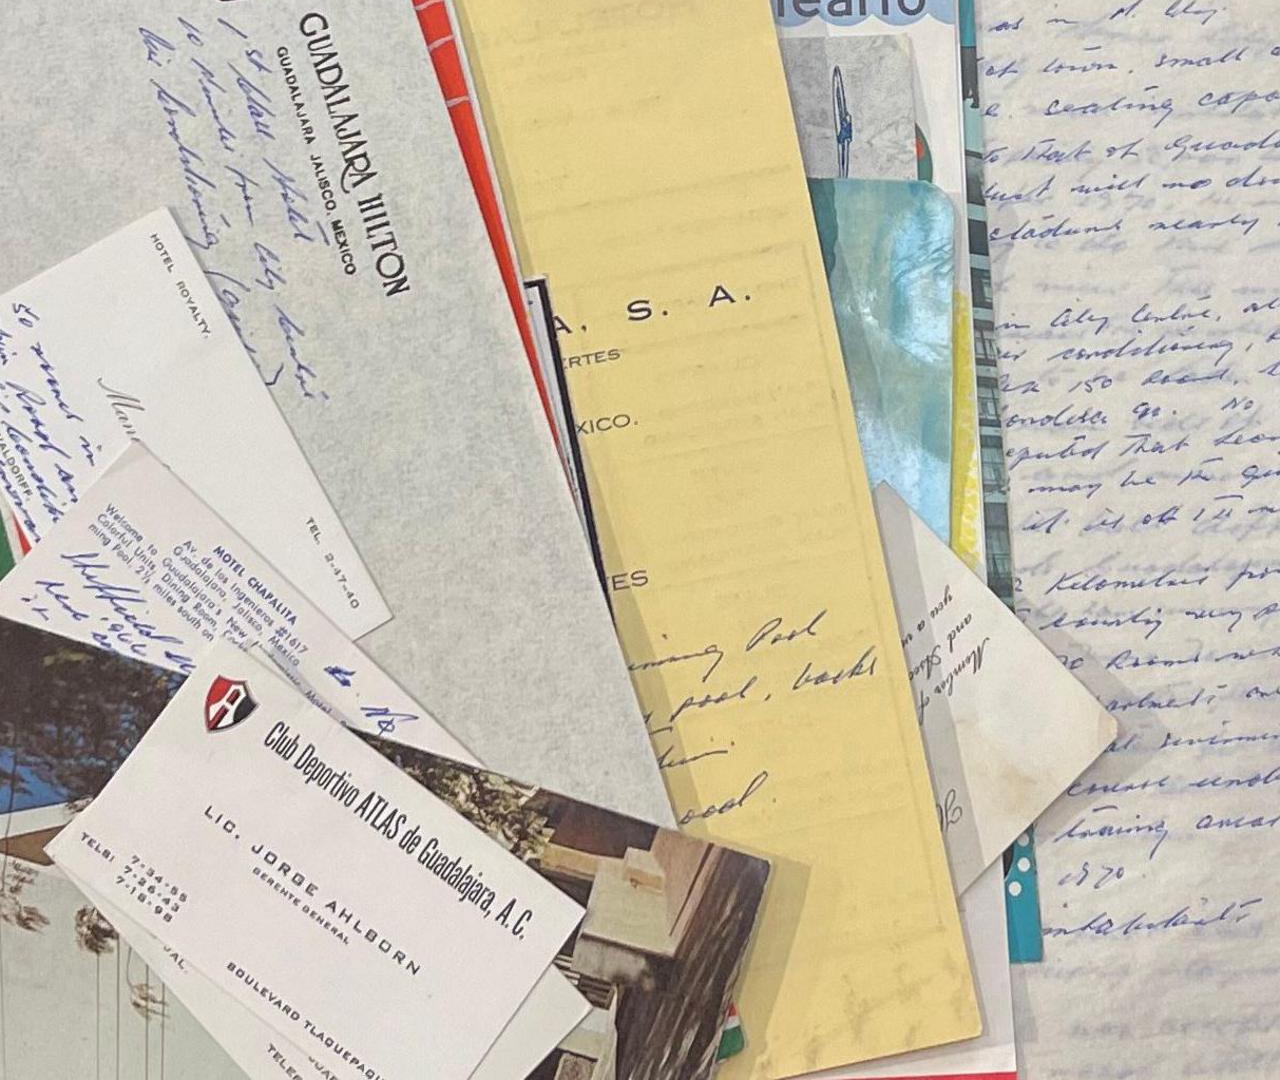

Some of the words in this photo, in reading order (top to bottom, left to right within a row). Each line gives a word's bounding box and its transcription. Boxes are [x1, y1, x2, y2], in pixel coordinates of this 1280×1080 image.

[276, 46, 315, 145] GUADALAJARA
[309, 153, 337, 216] JALISCO,
[330, 218, 357, 276] MEXICO
[298, 12, 378, 194] GUADALAJARA
[358, 192, 411, 297] HILTON
[149, 232, 176, 274] HOTEL
[627, 299, 669, 321] S.
[708, 285, 751, 308] A.
[88, 523, 111, 547] ming
[152, 582, 176, 608] miles
[177, 606, 202, 635] south
[201, 628, 215, 643] on
[97, 514, 133, 549] Colorful
[160, 574, 192, 605] Dining
[105, 503, 144, 543] Welcome
[147, 544, 159, 557] to
[226, 616, 248, 640] New
[213, 545, 244, 578] MOTEL
[247, 577, 298, 626] CHAPALITA
[608, 569, 650, 592] ES
[201, 556, 213, 570] de
[216, 569, 230, 585] los
[230, 582, 275, 628] Ingenieros
[275, 626, 309, 654] #1617
[930, 584, 953, 619] you
[947, 612, 973, 653] and
[268, 635, 301, 668] Mexico
[262, 719, 299, 759] Club
[293, 742, 361, 809] Deportivo
[355, 790, 408, 843] ATLAS
[402, 821, 422, 856] de
[417, 834, 496, 923] Guadalajara,
[494, 897, 534, 942] A.C.
[204, 805, 240, 840] LIC.
[251, 844, 319, 897] JORGE
[324, 900, 421, 976] AHLBORN
[252, 867, 302, 906] GERENTE
[301, 904, 350, 945] GENERAL
[226, 962, 301, 1021] BOULEVARD
